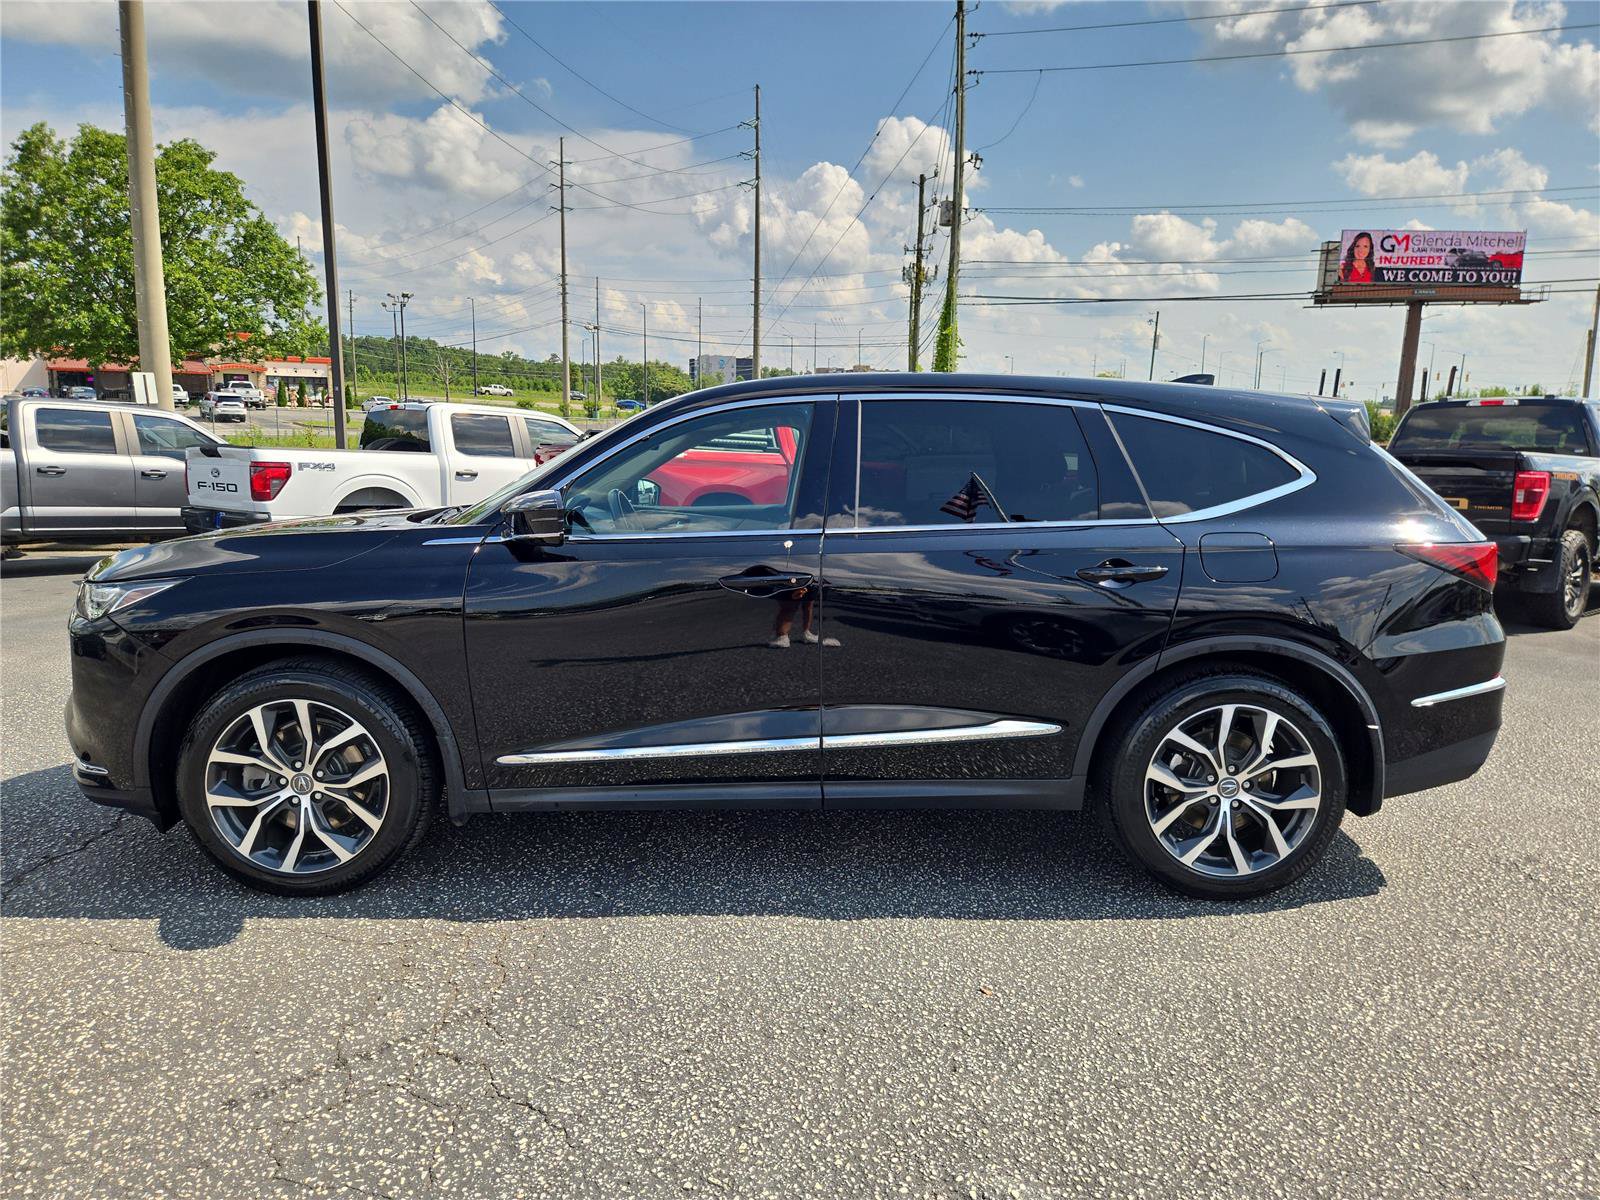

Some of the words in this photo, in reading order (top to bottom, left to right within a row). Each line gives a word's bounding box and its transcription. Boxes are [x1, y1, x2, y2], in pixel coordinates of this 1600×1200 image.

[1411, 234, 1462, 248] Glenda
[1466, 235, 1524, 249] Mitchell
[1379, 255, 1443, 266] INJURED?
[1382, 269, 1406, 282] WE
[1408, 270, 1453, 282] COME
[1457, 270, 1477, 283] TO
[1480, 271, 1517, 284] YOU!
[297, 462, 336, 471] FX4
[197, 481, 238, 493] F-150
